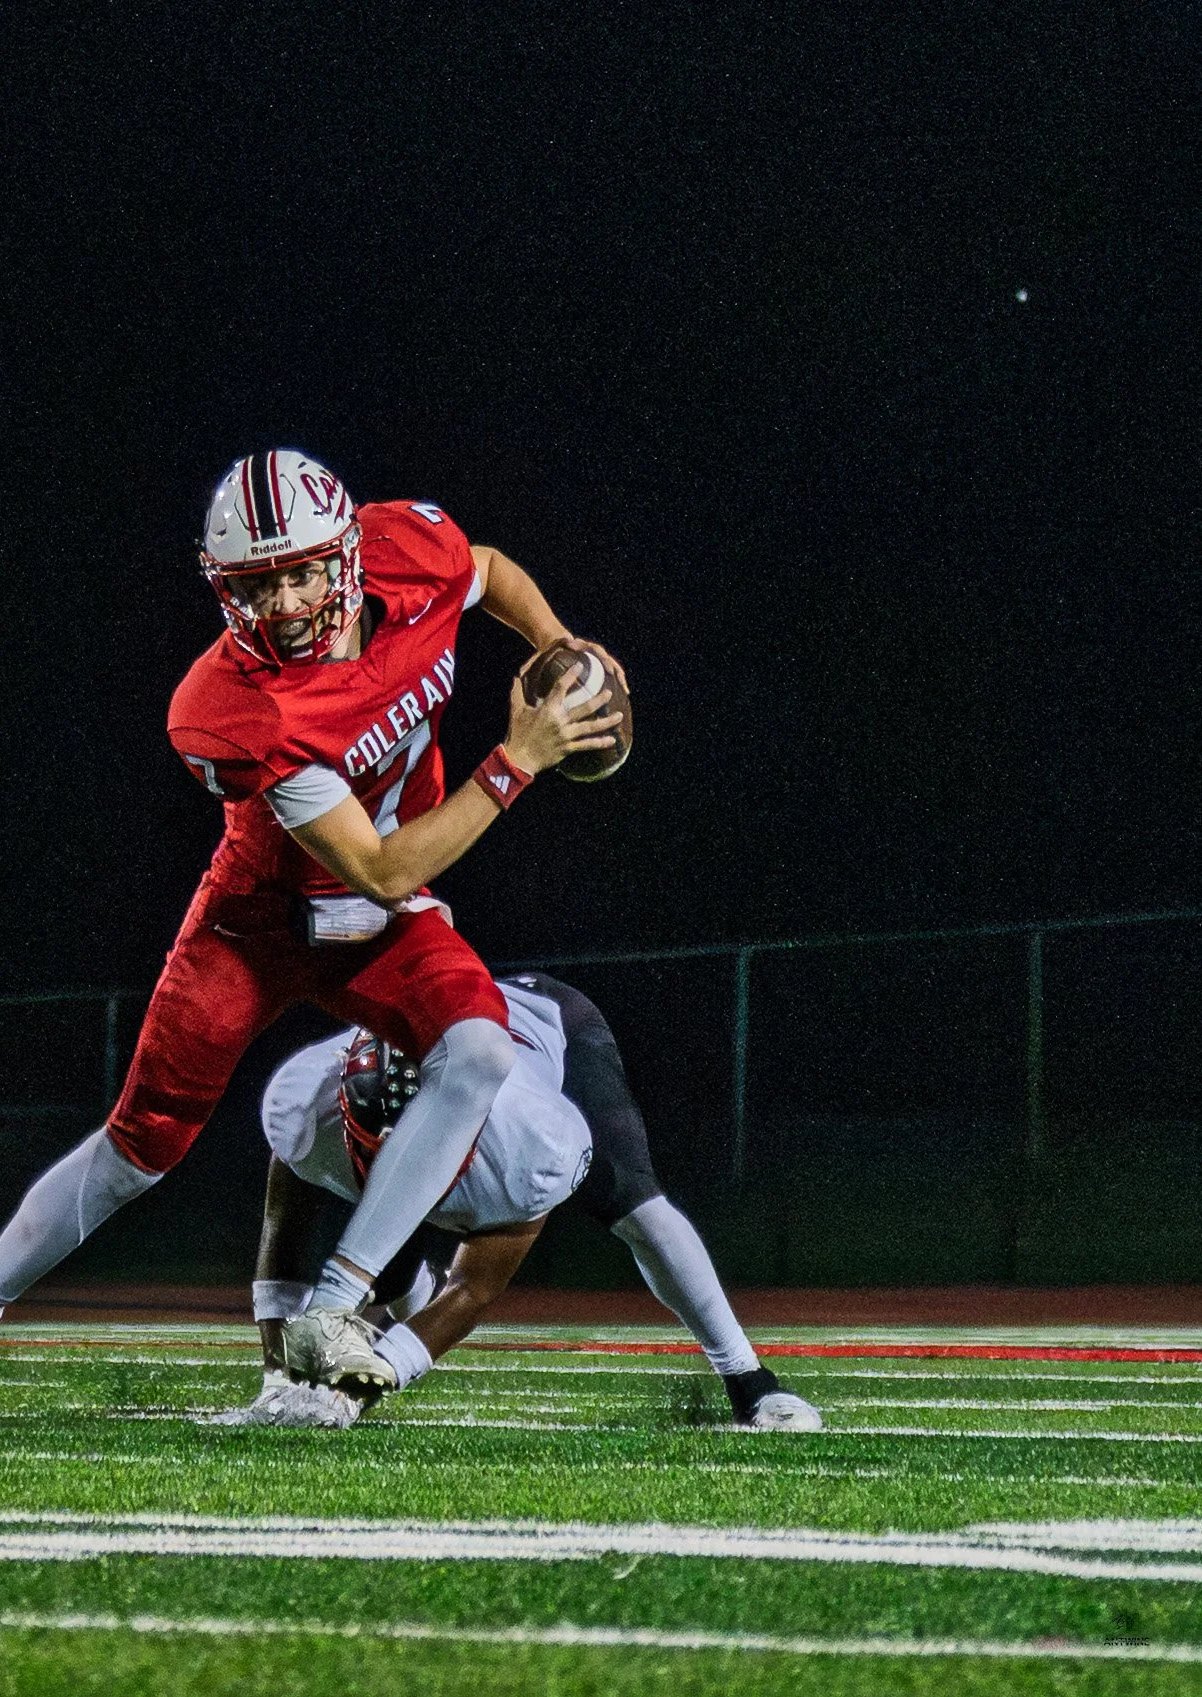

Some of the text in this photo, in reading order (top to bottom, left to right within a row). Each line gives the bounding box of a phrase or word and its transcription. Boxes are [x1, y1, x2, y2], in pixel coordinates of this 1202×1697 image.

[249, 539, 292, 556] Riddell
[344, 648, 455, 777] COLERAIN
[184, 753, 225, 795] 7
[374, 717, 432, 838] 7
